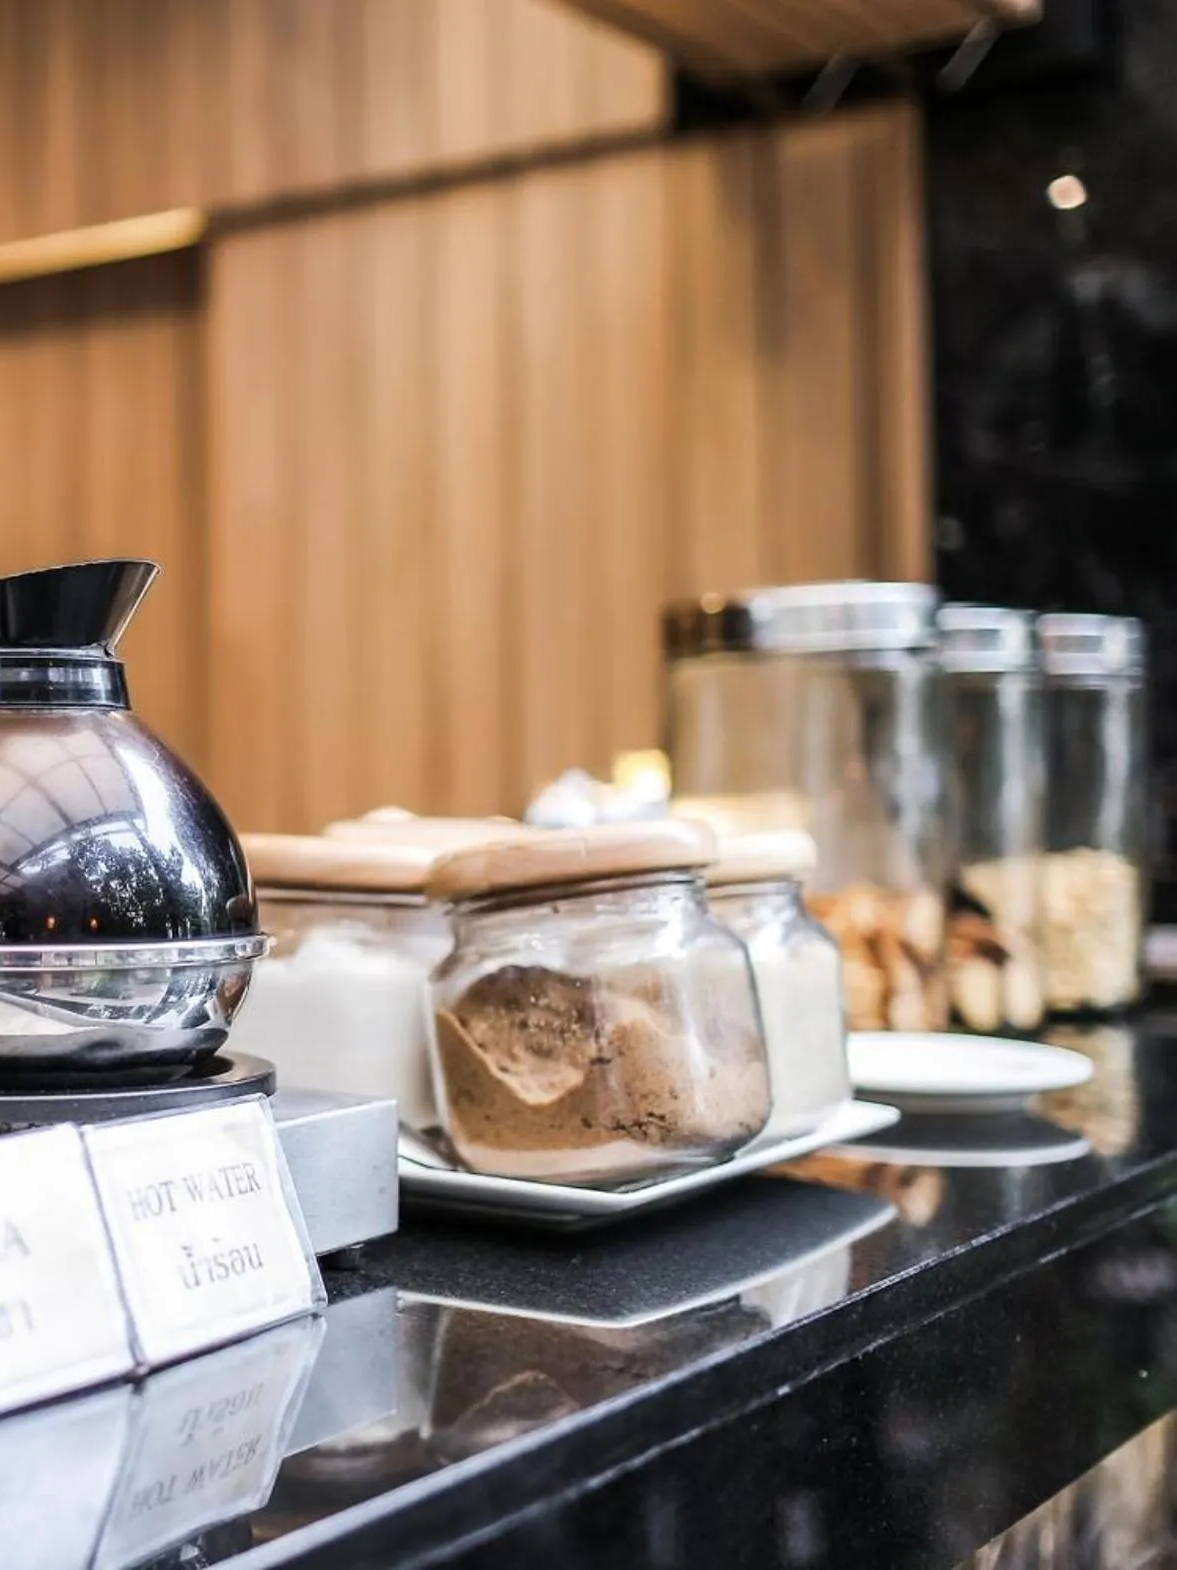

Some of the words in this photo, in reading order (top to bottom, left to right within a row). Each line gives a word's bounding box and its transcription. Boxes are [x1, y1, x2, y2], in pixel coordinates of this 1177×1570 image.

[128, 1180, 178, 1221] HOT
[183, 1163, 262, 1205] WATER
[177, 1237, 265, 1291] น้ำร้อน
